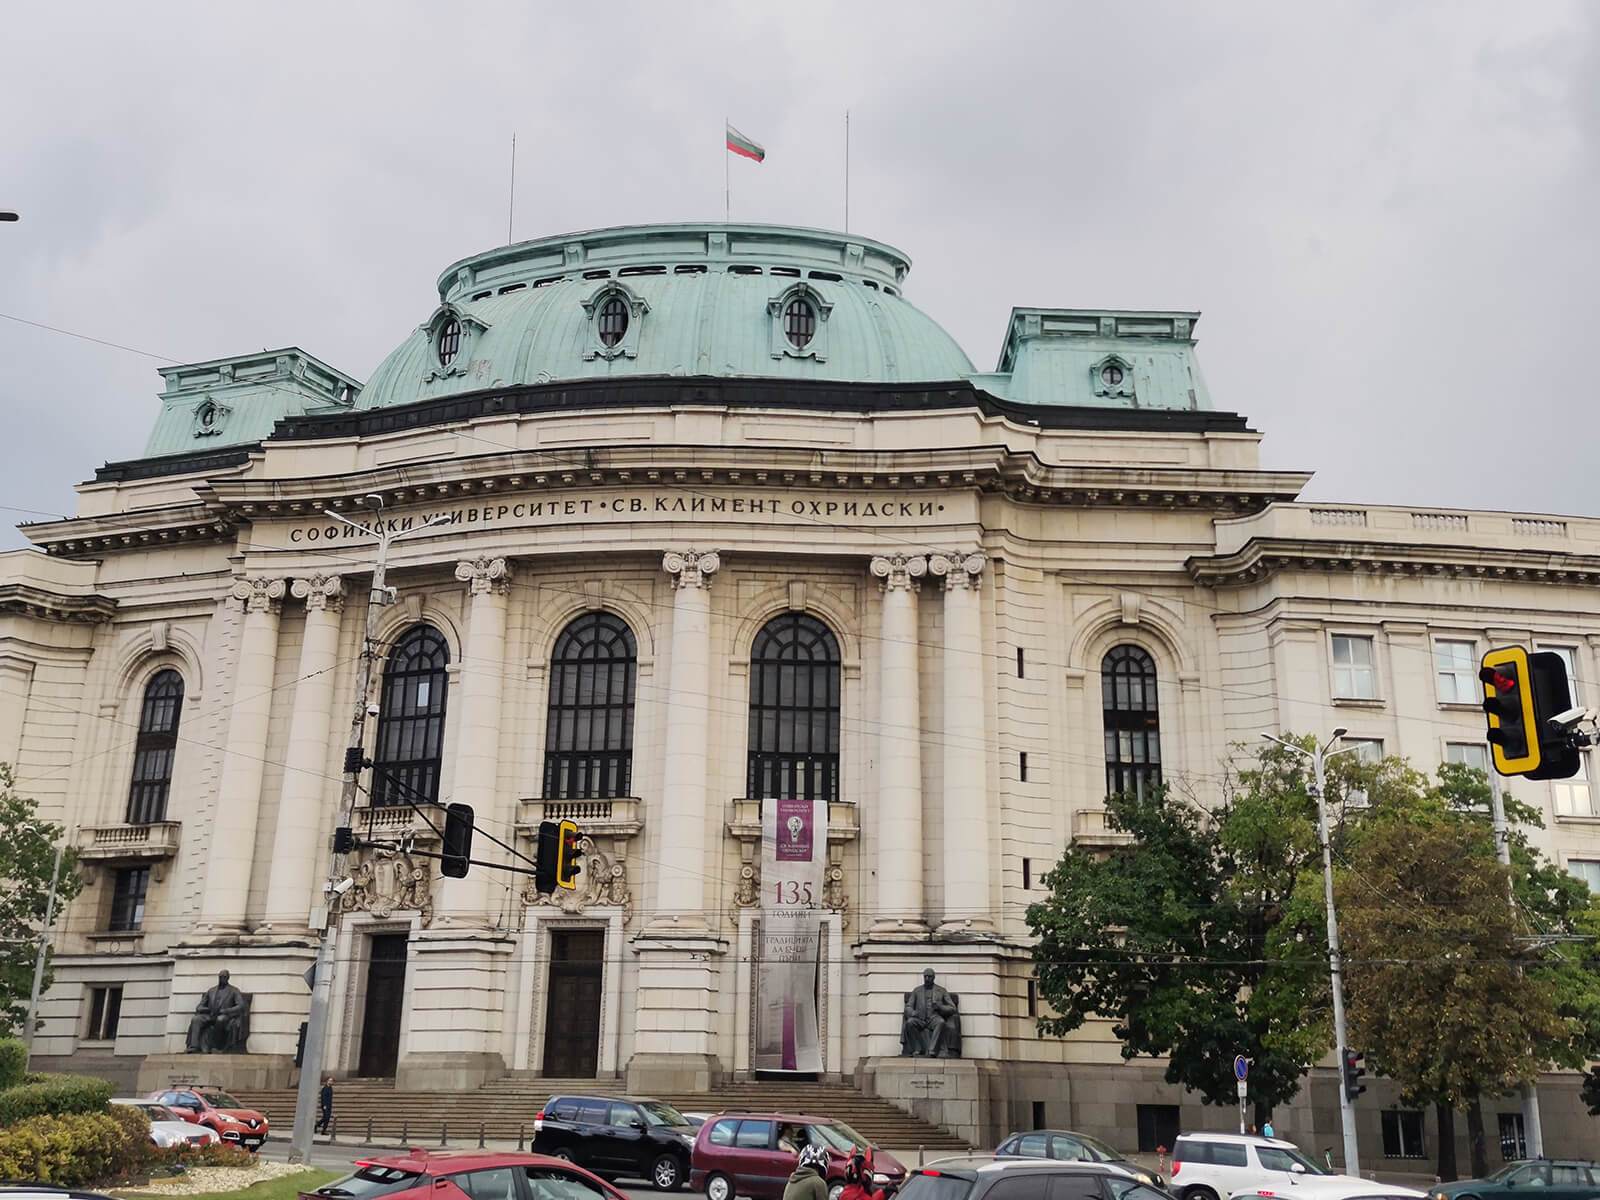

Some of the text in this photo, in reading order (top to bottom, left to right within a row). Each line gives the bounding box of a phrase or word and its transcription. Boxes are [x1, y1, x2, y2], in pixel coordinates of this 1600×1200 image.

[422, 500, 592, 525] УИВЕРСИТЕТ
[612, 498, 647, 512] СВ.
[655, 497, 782, 513] КЛИМЕНТ
[791, 500, 934, 517] ОХРИДСКИ
[774, 880, 813, 905] 135
